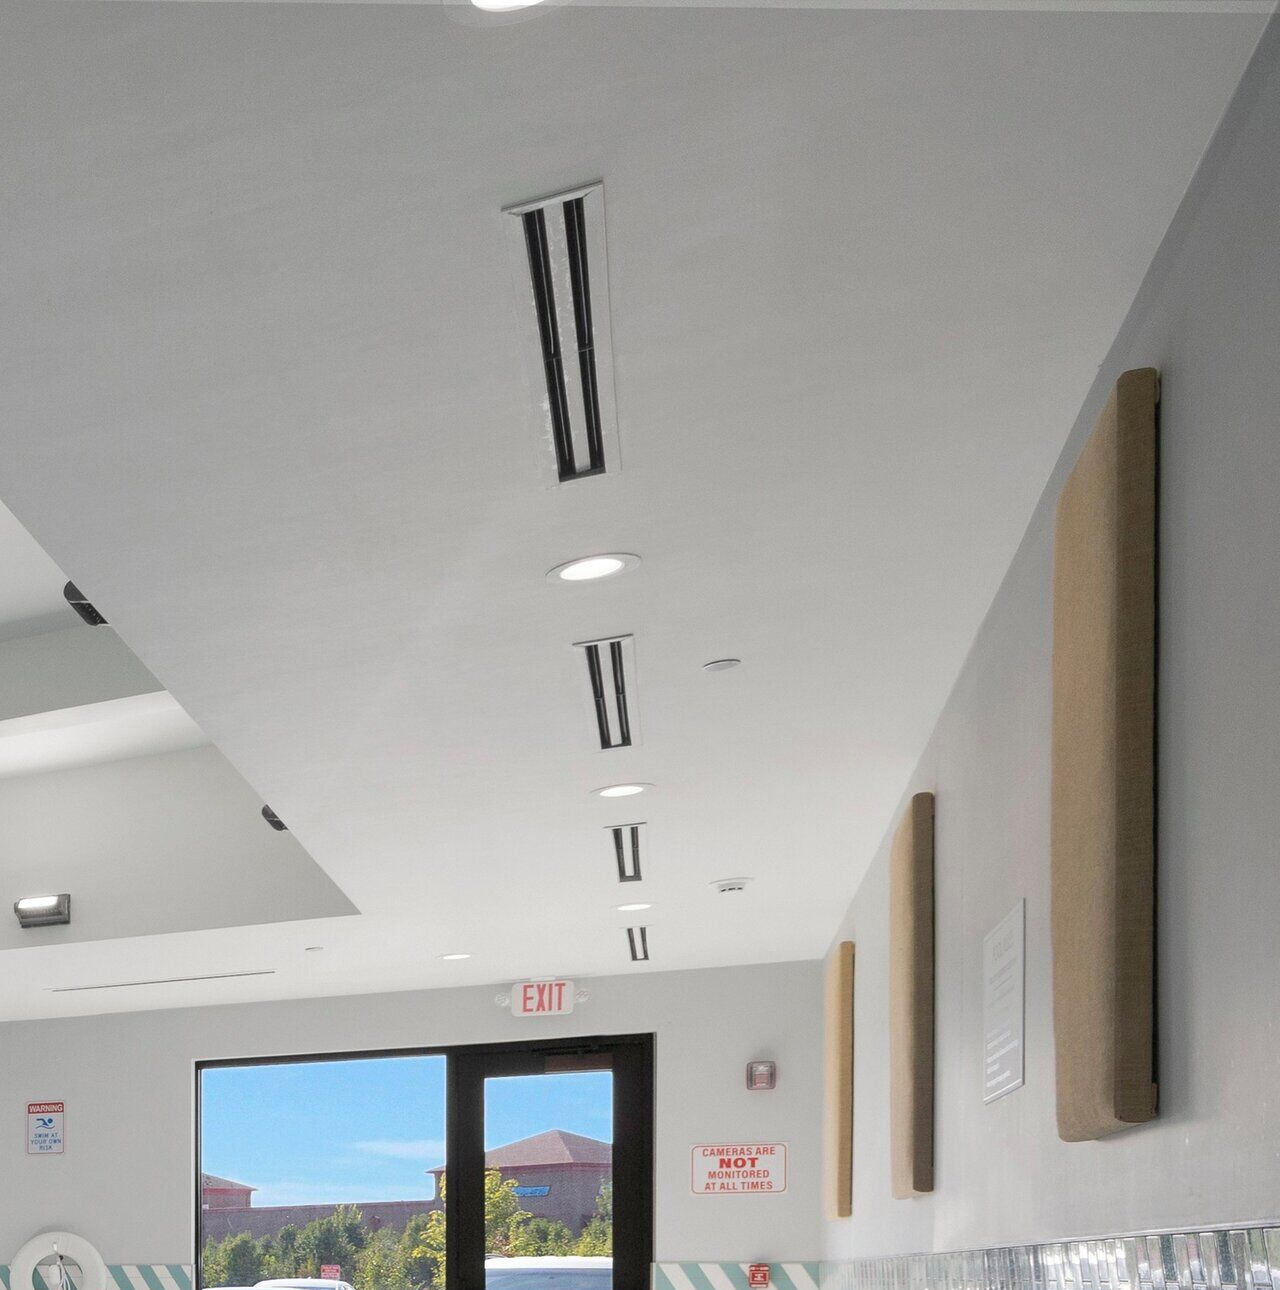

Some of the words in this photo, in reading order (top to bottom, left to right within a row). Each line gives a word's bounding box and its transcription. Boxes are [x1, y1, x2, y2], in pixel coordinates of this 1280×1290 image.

[523, 983, 566, 1012] EXIT
[29, 1104, 63, 1113] WARNING
[702, 1147, 753, 1157] CAMERAS
[755, 1146, 776, 1155] ARE
[719, 1157, 759, 1169] NOT
[708, 1170, 770, 1179] MONITORED
[704, 1182, 717, 1191] AT
[720, 1182, 738, 1190] ALL
[740, 1181, 773, 1190] TIMES
